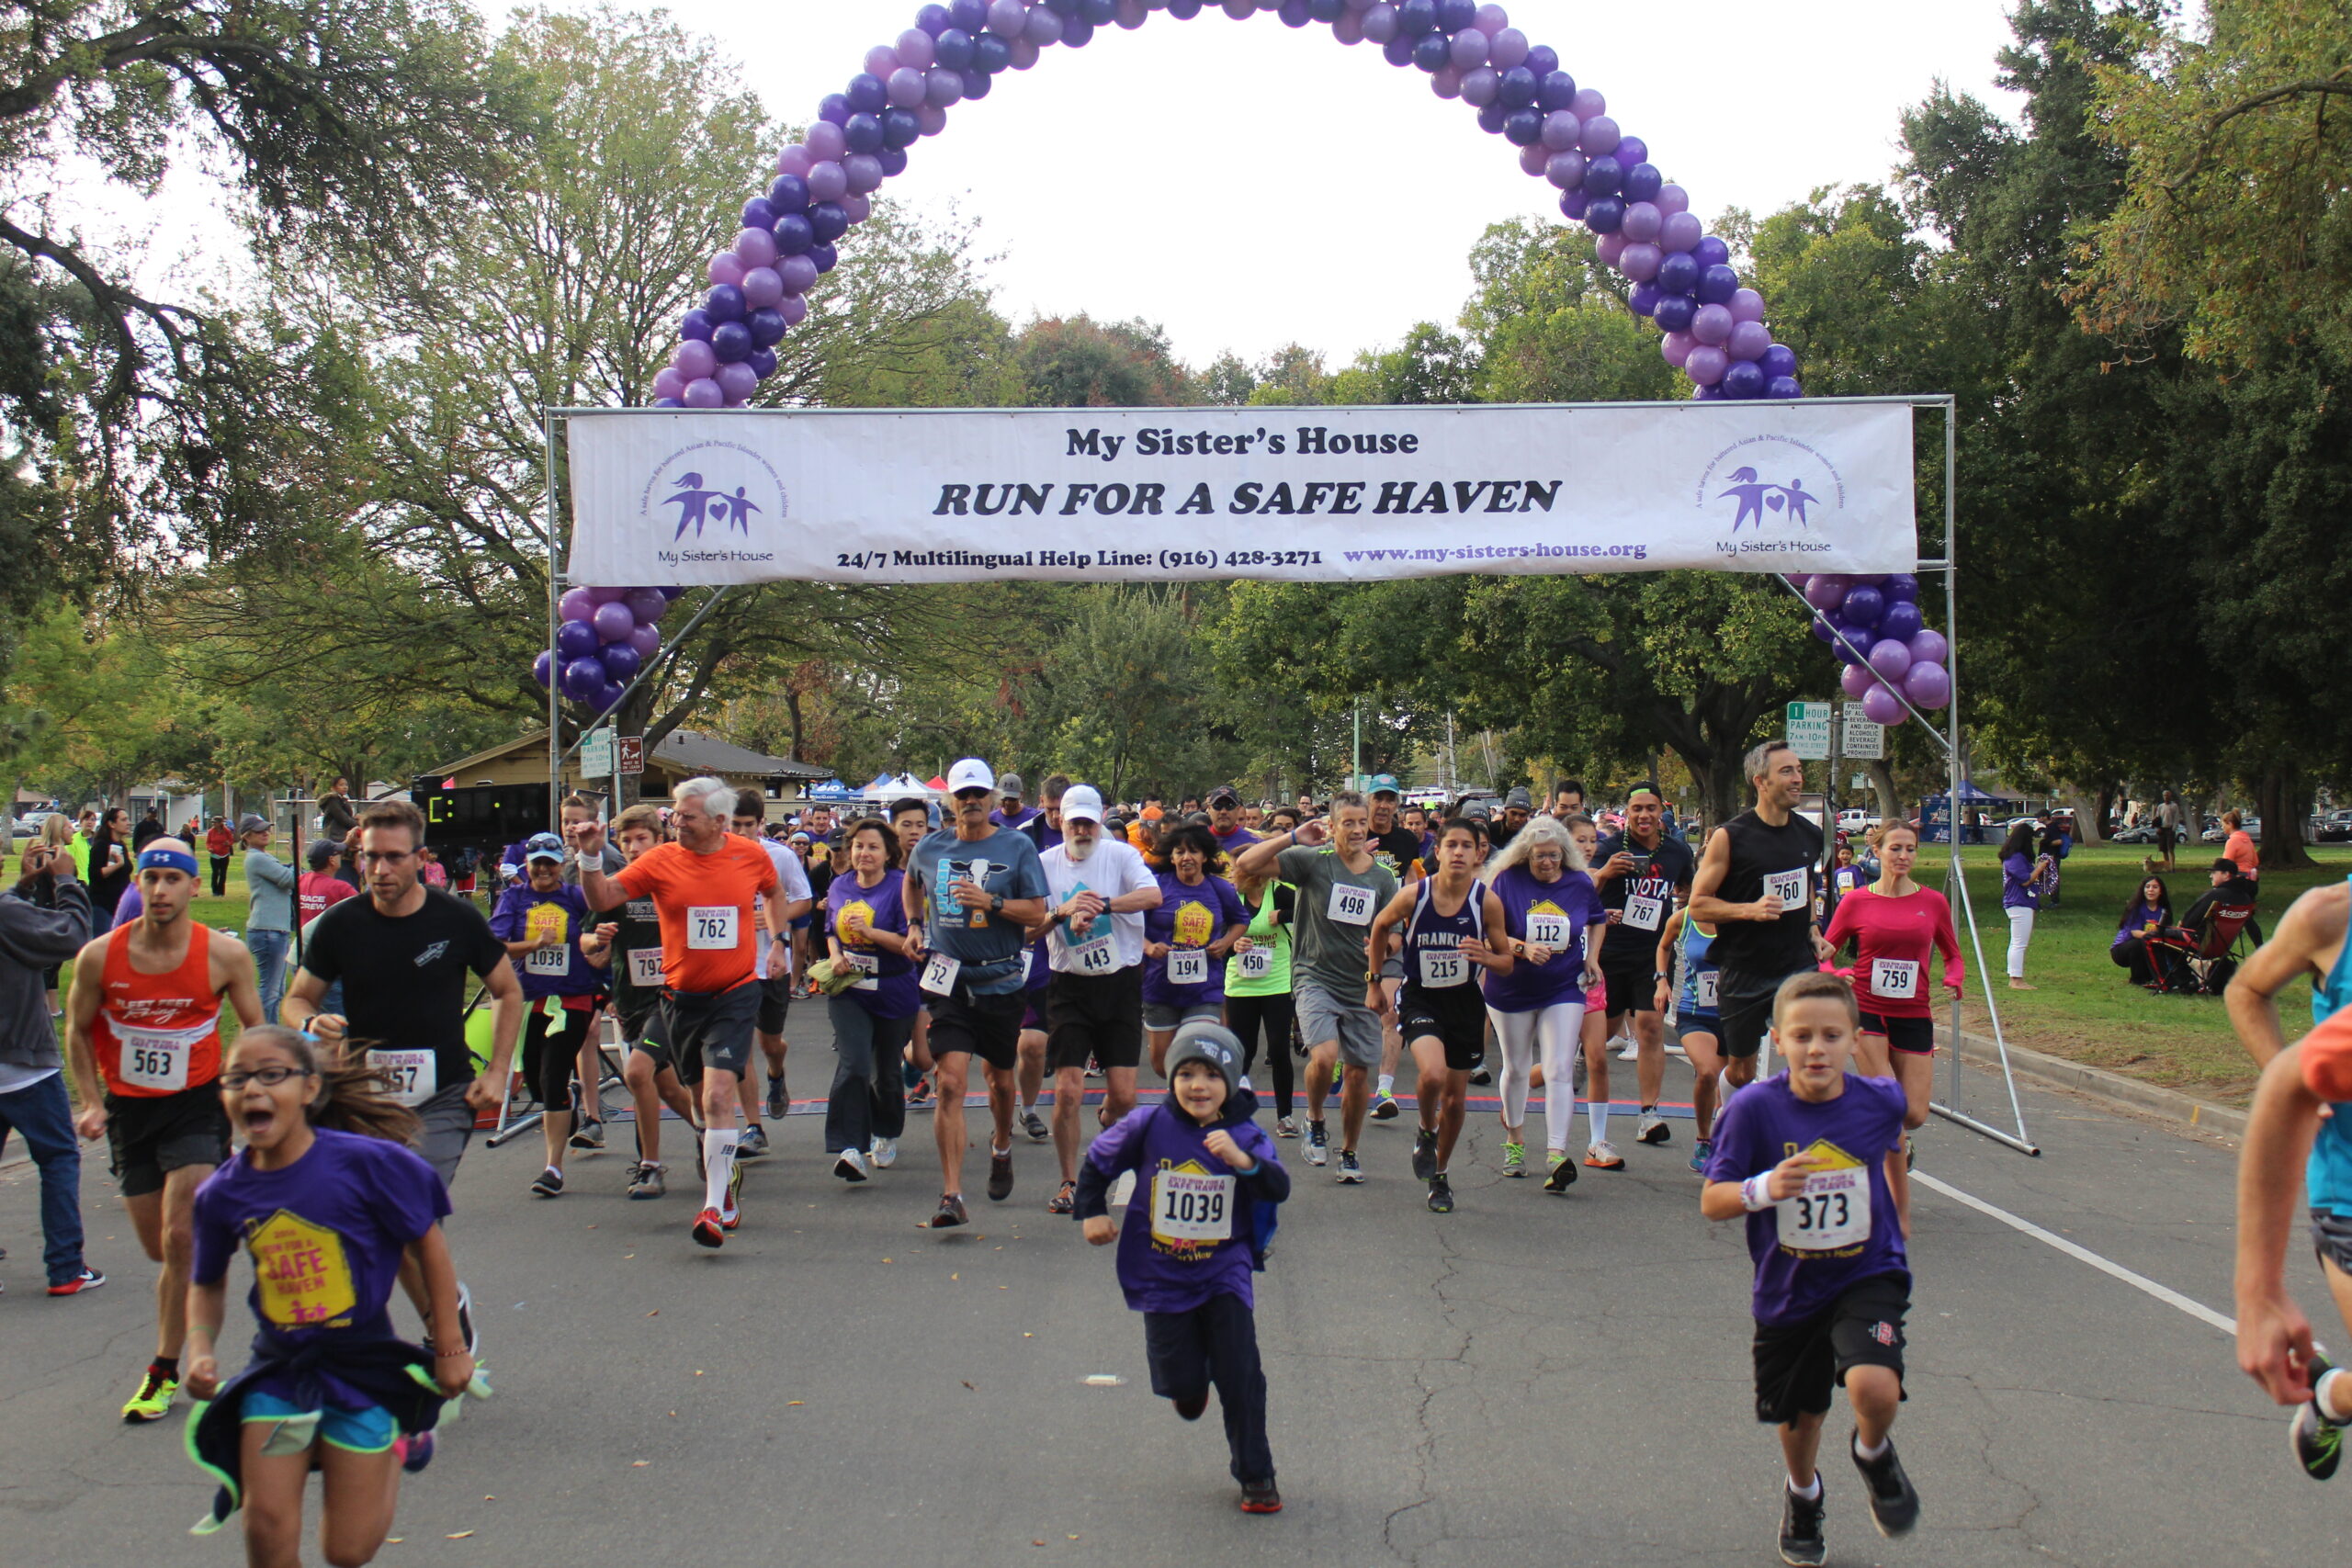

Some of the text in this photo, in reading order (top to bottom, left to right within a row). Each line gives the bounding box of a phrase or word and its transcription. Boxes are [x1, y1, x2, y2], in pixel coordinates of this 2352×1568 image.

[1066, 426, 1419, 462] My Sister's House
[1707, 460, 1716, 470] for
[1766, 434, 1788, 443] Pacific
[1790, 437, 1815, 454] Islander
[653, 466, 663, 476] for
[714, 440, 736, 449] Pacific
[737, 444, 762, 461] Islander
[932, 480, 1564, 515] RUN FOR A SAFE HAVEN
[837, 542, 1647, 570] 24/7 Multilingual Help Line: (916) 428-3271 www.my-sisters-house.org
[1716, 540, 1832, 558] My Sister's House
[659, 550, 774, 567] My Sister's House
[1794, 705, 1828, 718] 1 HOUR
[1790, 721, 1827, 730] PARKING
[300, 895, 325, 903] RACE
[1774, 881, 1799, 901] 760
[1340, 896, 1365, 916] 498
[1633, 905, 1654, 922] 767
[698, 919, 726, 938] 762
[1182, 916, 1207, 928] SAFE
[1418, 931, 1464, 947] FRANKL
[1535, 925, 1559, 942] 112
[530, 950, 563, 966] 1038
[1084, 948, 1110, 970] 443
[1243, 955, 1263, 970] 450
[1177, 960, 1198, 976] 194
[1430, 961, 1458, 978] 215
[1883, 970, 1908, 988] 759
[134, 1049, 172, 1076] 563
[1165, 1190, 1224, 1223] 1039
[1796, 1192, 1849, 1230] 373
[264, 1247, 328, 1280] SAFE
[1194, 1250, 1213, 1261] Hou
